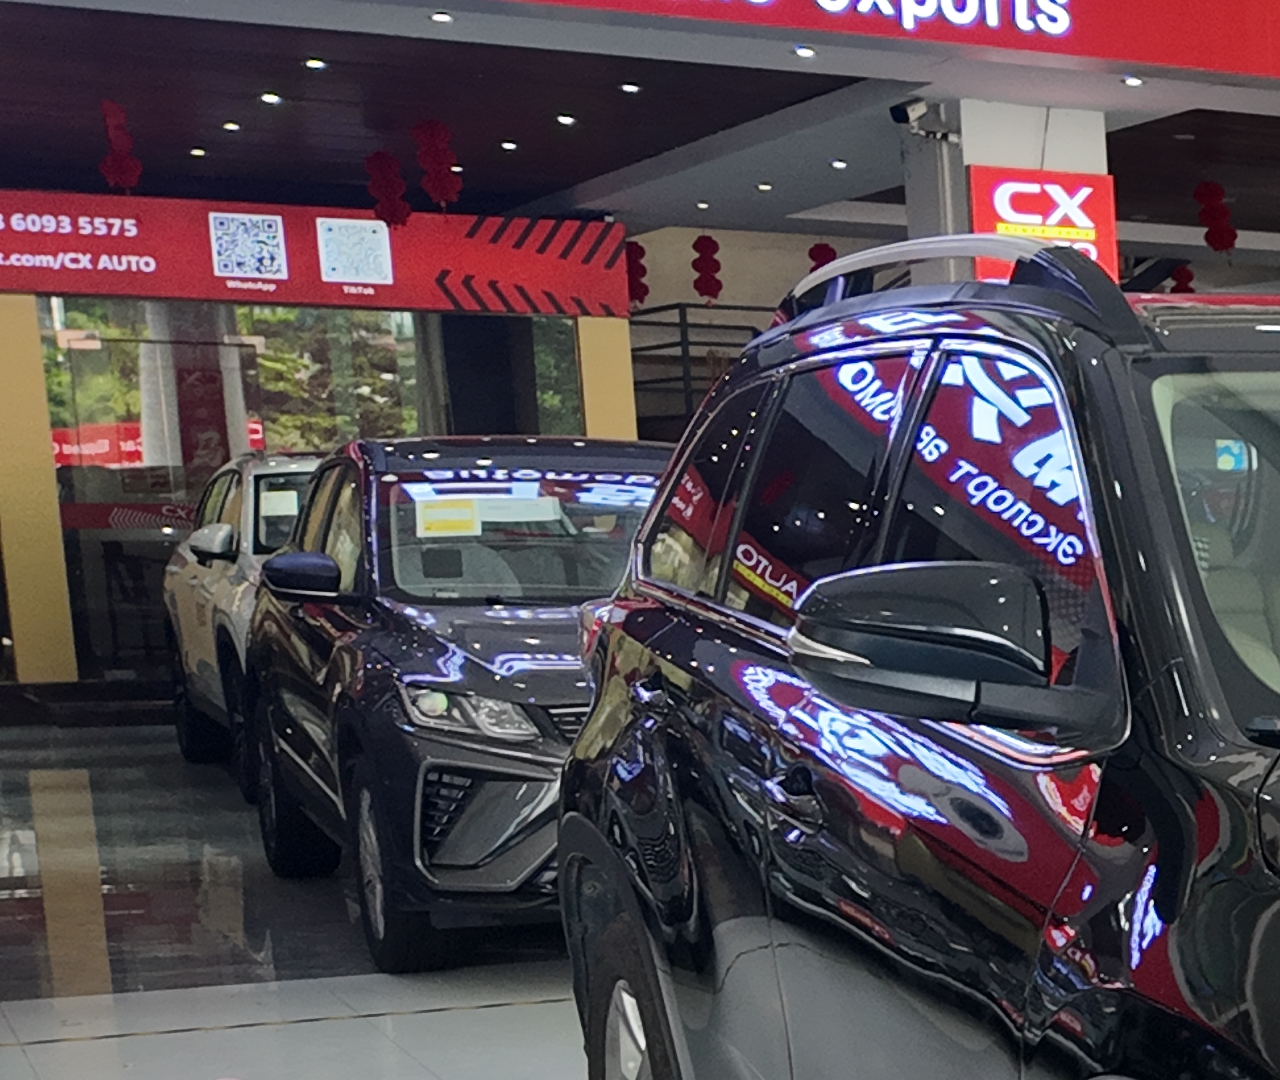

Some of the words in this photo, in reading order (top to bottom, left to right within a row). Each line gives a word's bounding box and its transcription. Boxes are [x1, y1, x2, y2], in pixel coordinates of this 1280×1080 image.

[993, 182, 1096, 228] CX
[10, 213, 72, 234] 6093
[78, 216, 138, 237] 5575
[98, 255, 156, 273] AUTO
[225, 279, 277, 293] WhatsApp
